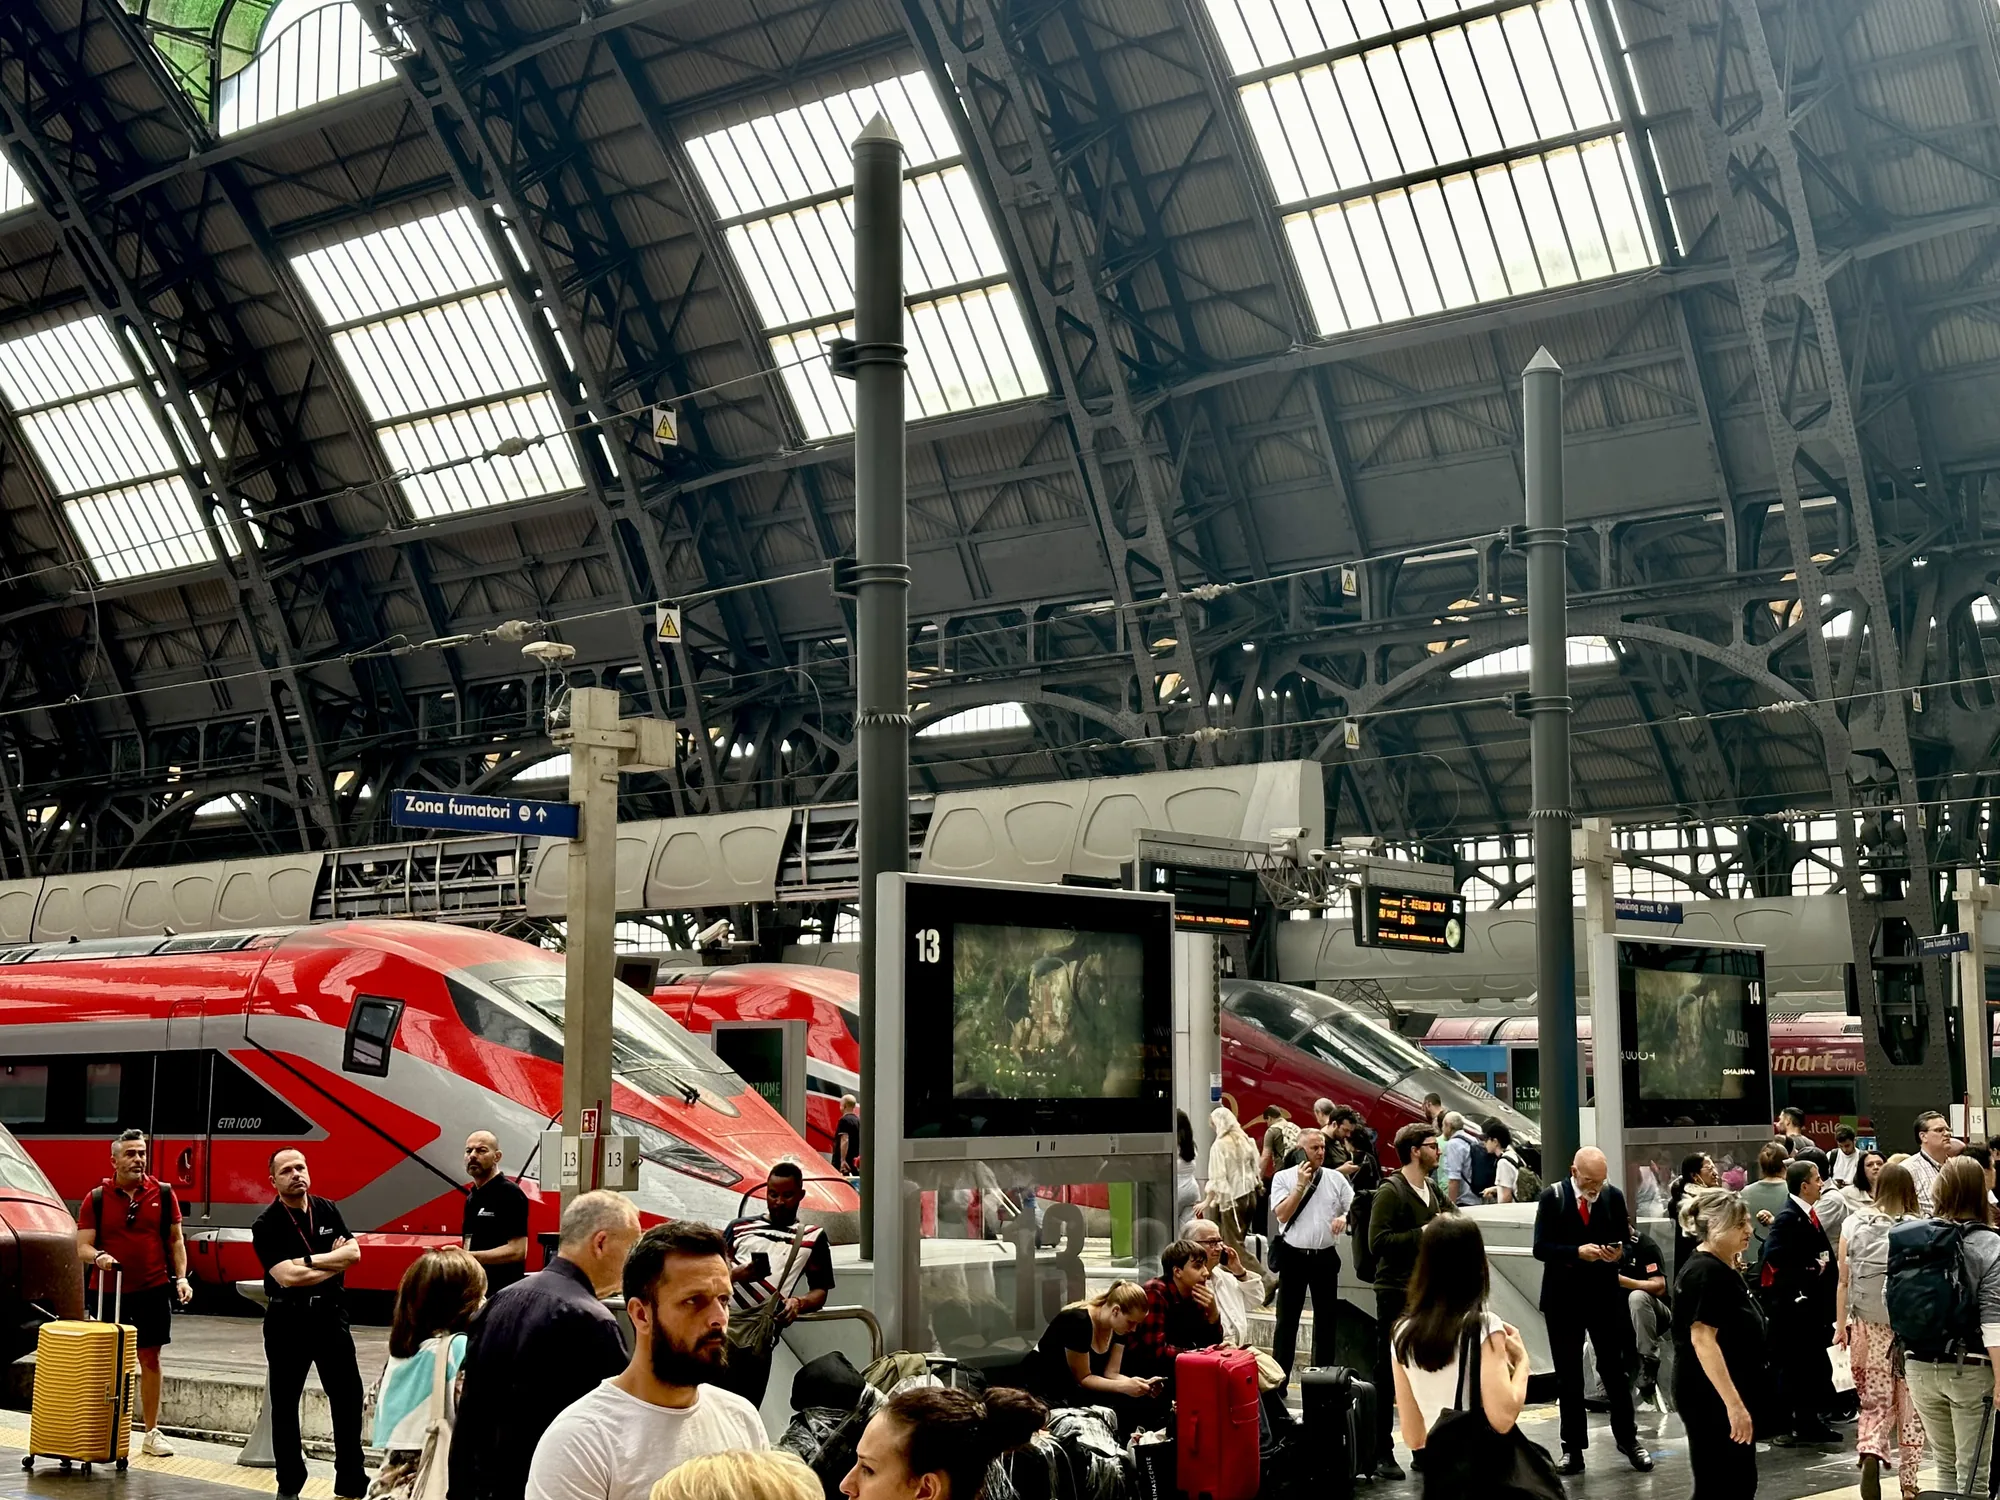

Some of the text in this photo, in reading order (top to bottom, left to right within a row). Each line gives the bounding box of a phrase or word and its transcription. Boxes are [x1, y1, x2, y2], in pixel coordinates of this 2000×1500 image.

[405, 796, 511, 819] Zona fumatori
[1155, 868, 1165, 883] 14
[1452, 900, 1460, 913] 15
[1615, 900, 1654, 914] moking area
[915, 929, 940, 963] 13
[1748, 982, 1760, 1005] 14
[1835, 1057, 1867, 1072] Cine
[1972, 1115, 1981, 1124] 15
[564, 1151, 576, 1167] 13
[607, 1151, 622, 1167] 13
